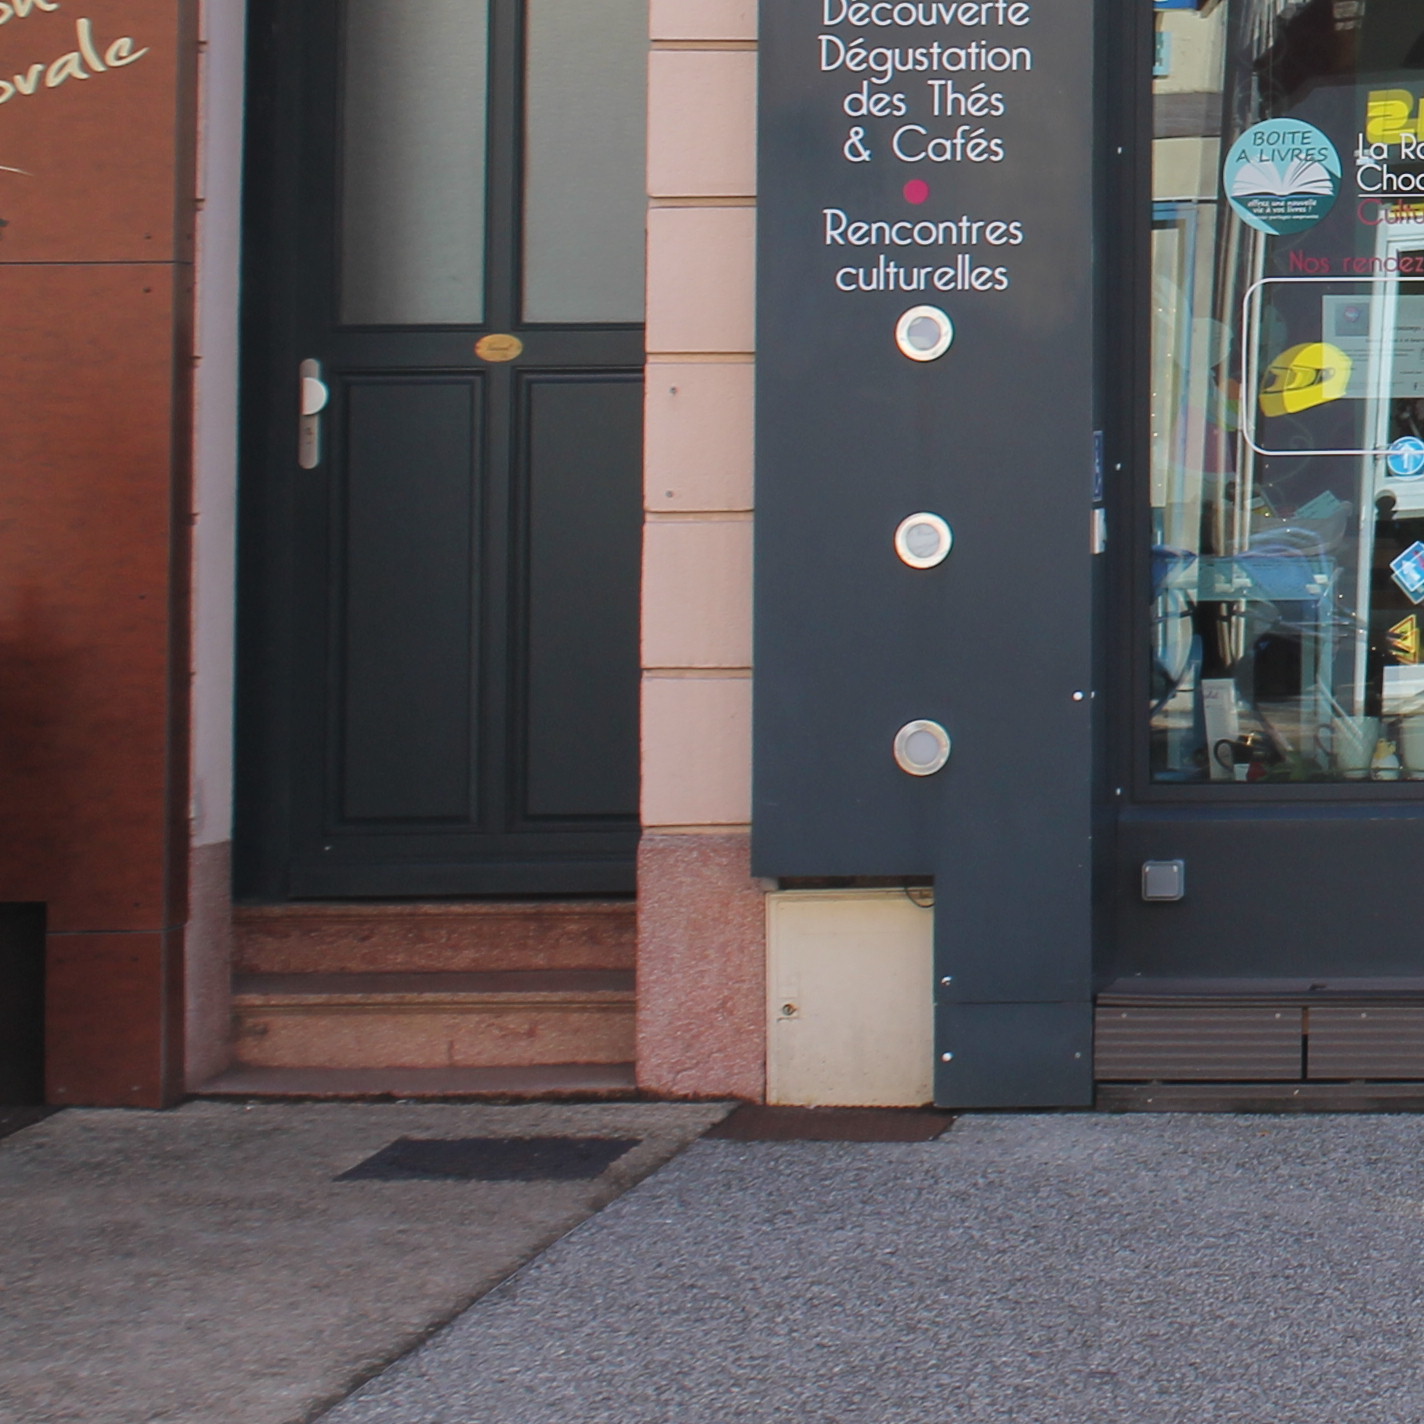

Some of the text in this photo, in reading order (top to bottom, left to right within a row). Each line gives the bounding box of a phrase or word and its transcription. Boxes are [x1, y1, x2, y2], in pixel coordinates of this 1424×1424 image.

[818, 35, 1032, 84] Dégustation
[843, 80, 1005, 117] des Thés
[843, 124, 1004, 162] & Cafés
[1235, 147, 1329, 163] A LIVRES
[1252, 130, 1313, 146] BOITE
[1356, 133, 1388, 160] La
[822, 209, 1023, 246] Rencontres
[835, 254, 1009, 291] culturelles
[1289, 252, 1330, 273] Nos
